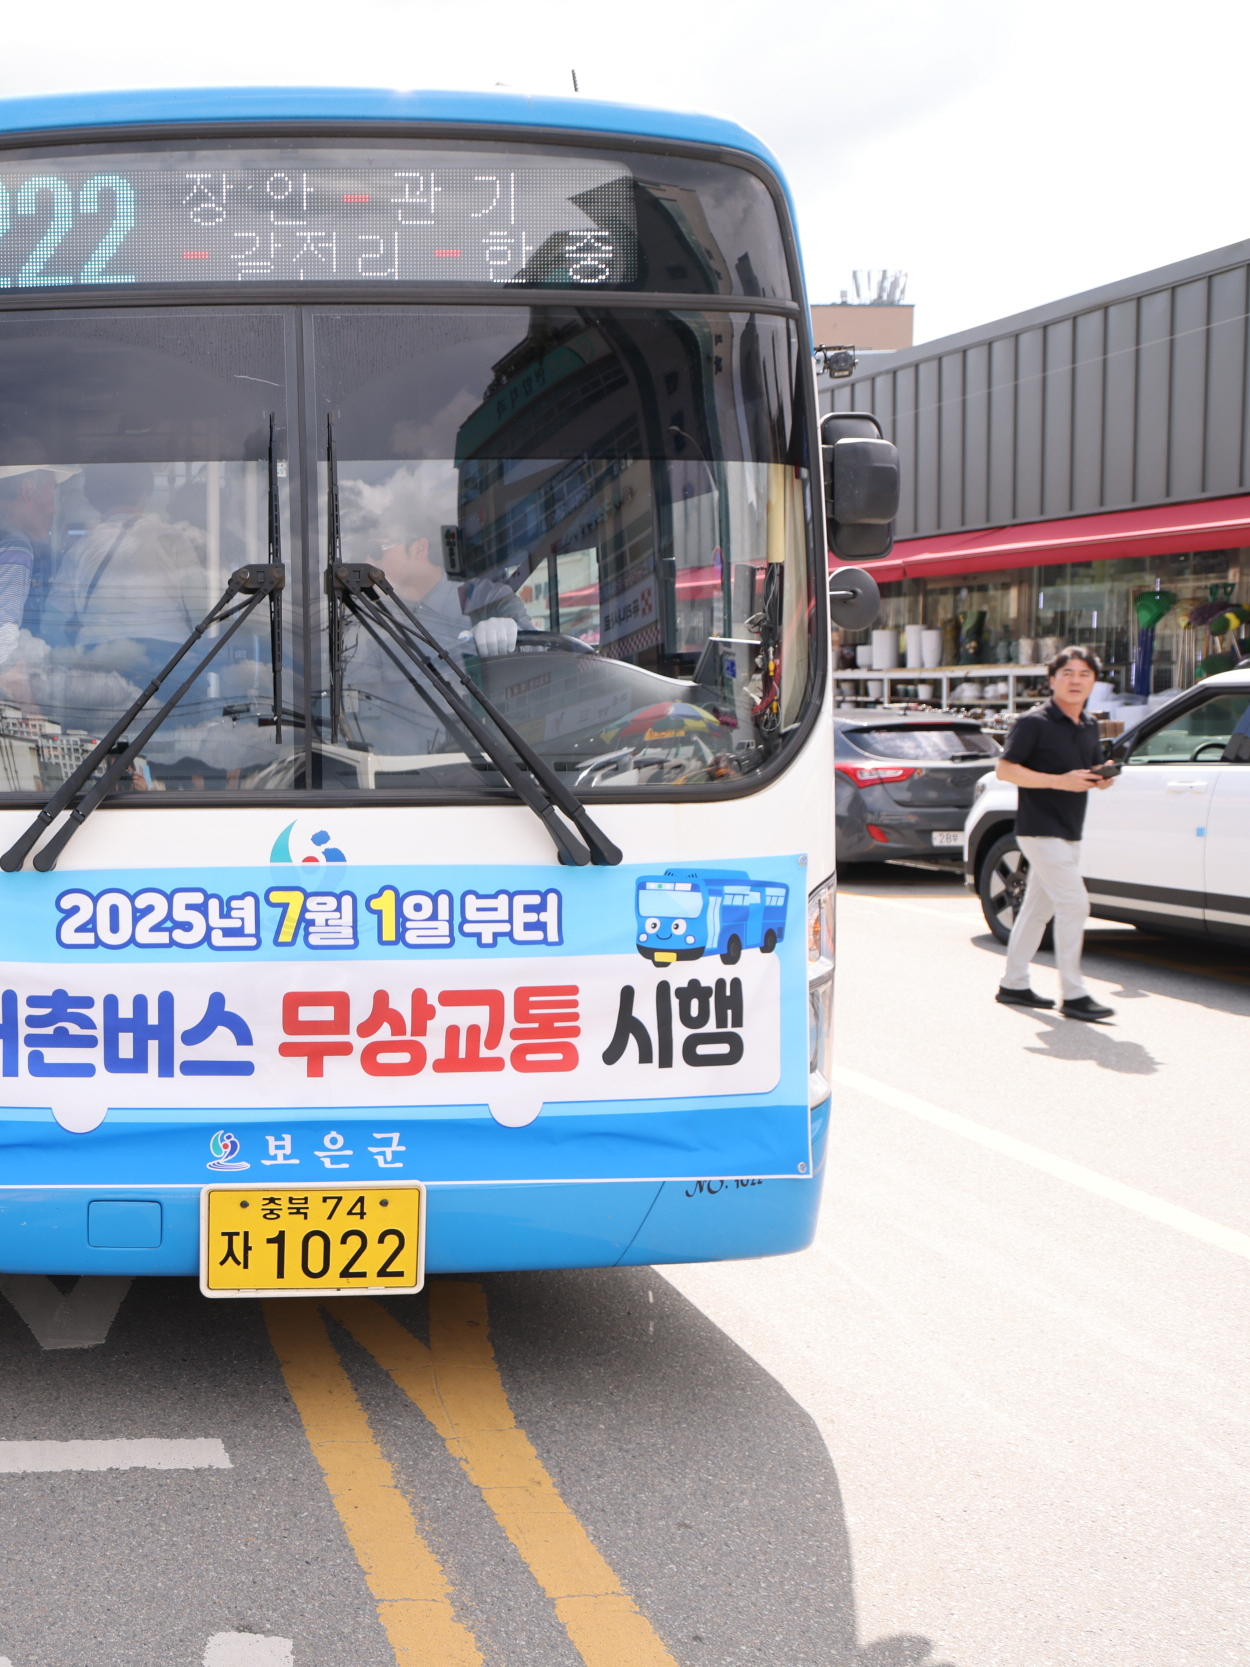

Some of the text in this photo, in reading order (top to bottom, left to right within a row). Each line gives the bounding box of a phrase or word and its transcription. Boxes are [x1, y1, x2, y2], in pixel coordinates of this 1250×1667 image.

[391, 172, 515, 225] 관기
[57, 886, 562, 949] 2025년 7월 1일 부터
[278, 984, 582, 1078] 무상교통
[602, 976, 745, 1069] 시행
[260, 1131, 407, 1168] 보은군
[261, 1195, 367, 1220] 충북 74
[219, 1229, 406, 1279] 자 1022
